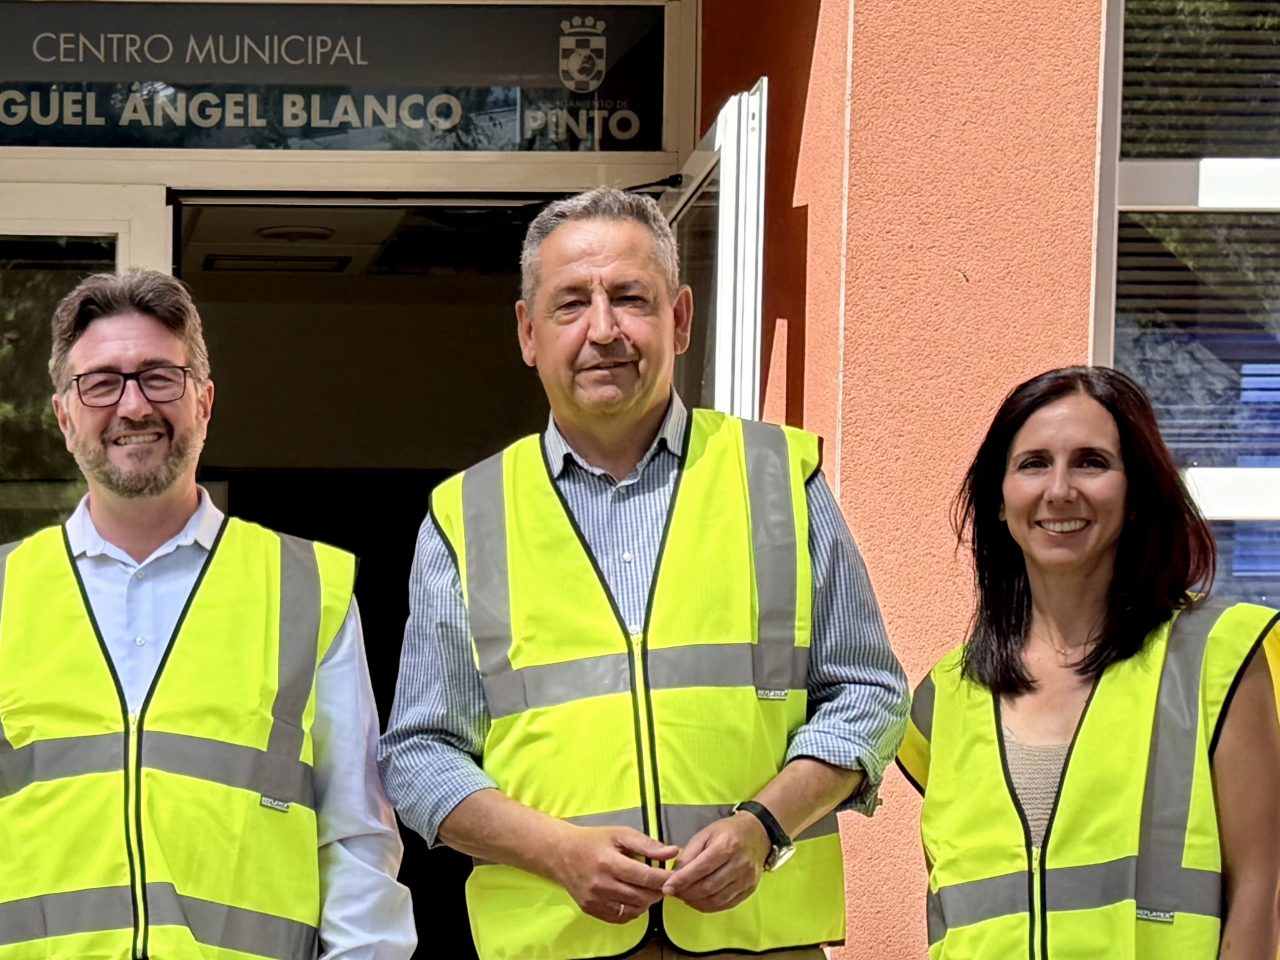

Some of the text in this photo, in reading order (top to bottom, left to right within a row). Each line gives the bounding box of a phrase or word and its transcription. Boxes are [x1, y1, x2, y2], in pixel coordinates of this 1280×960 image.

[32, 31, 370, 66] CENTRO MUNICIPAL
[118, 81, 267, 128] ÁNGEL
[282, 93, 463, 130] BLANCO
[523, 109, 641, 140] PINTO
